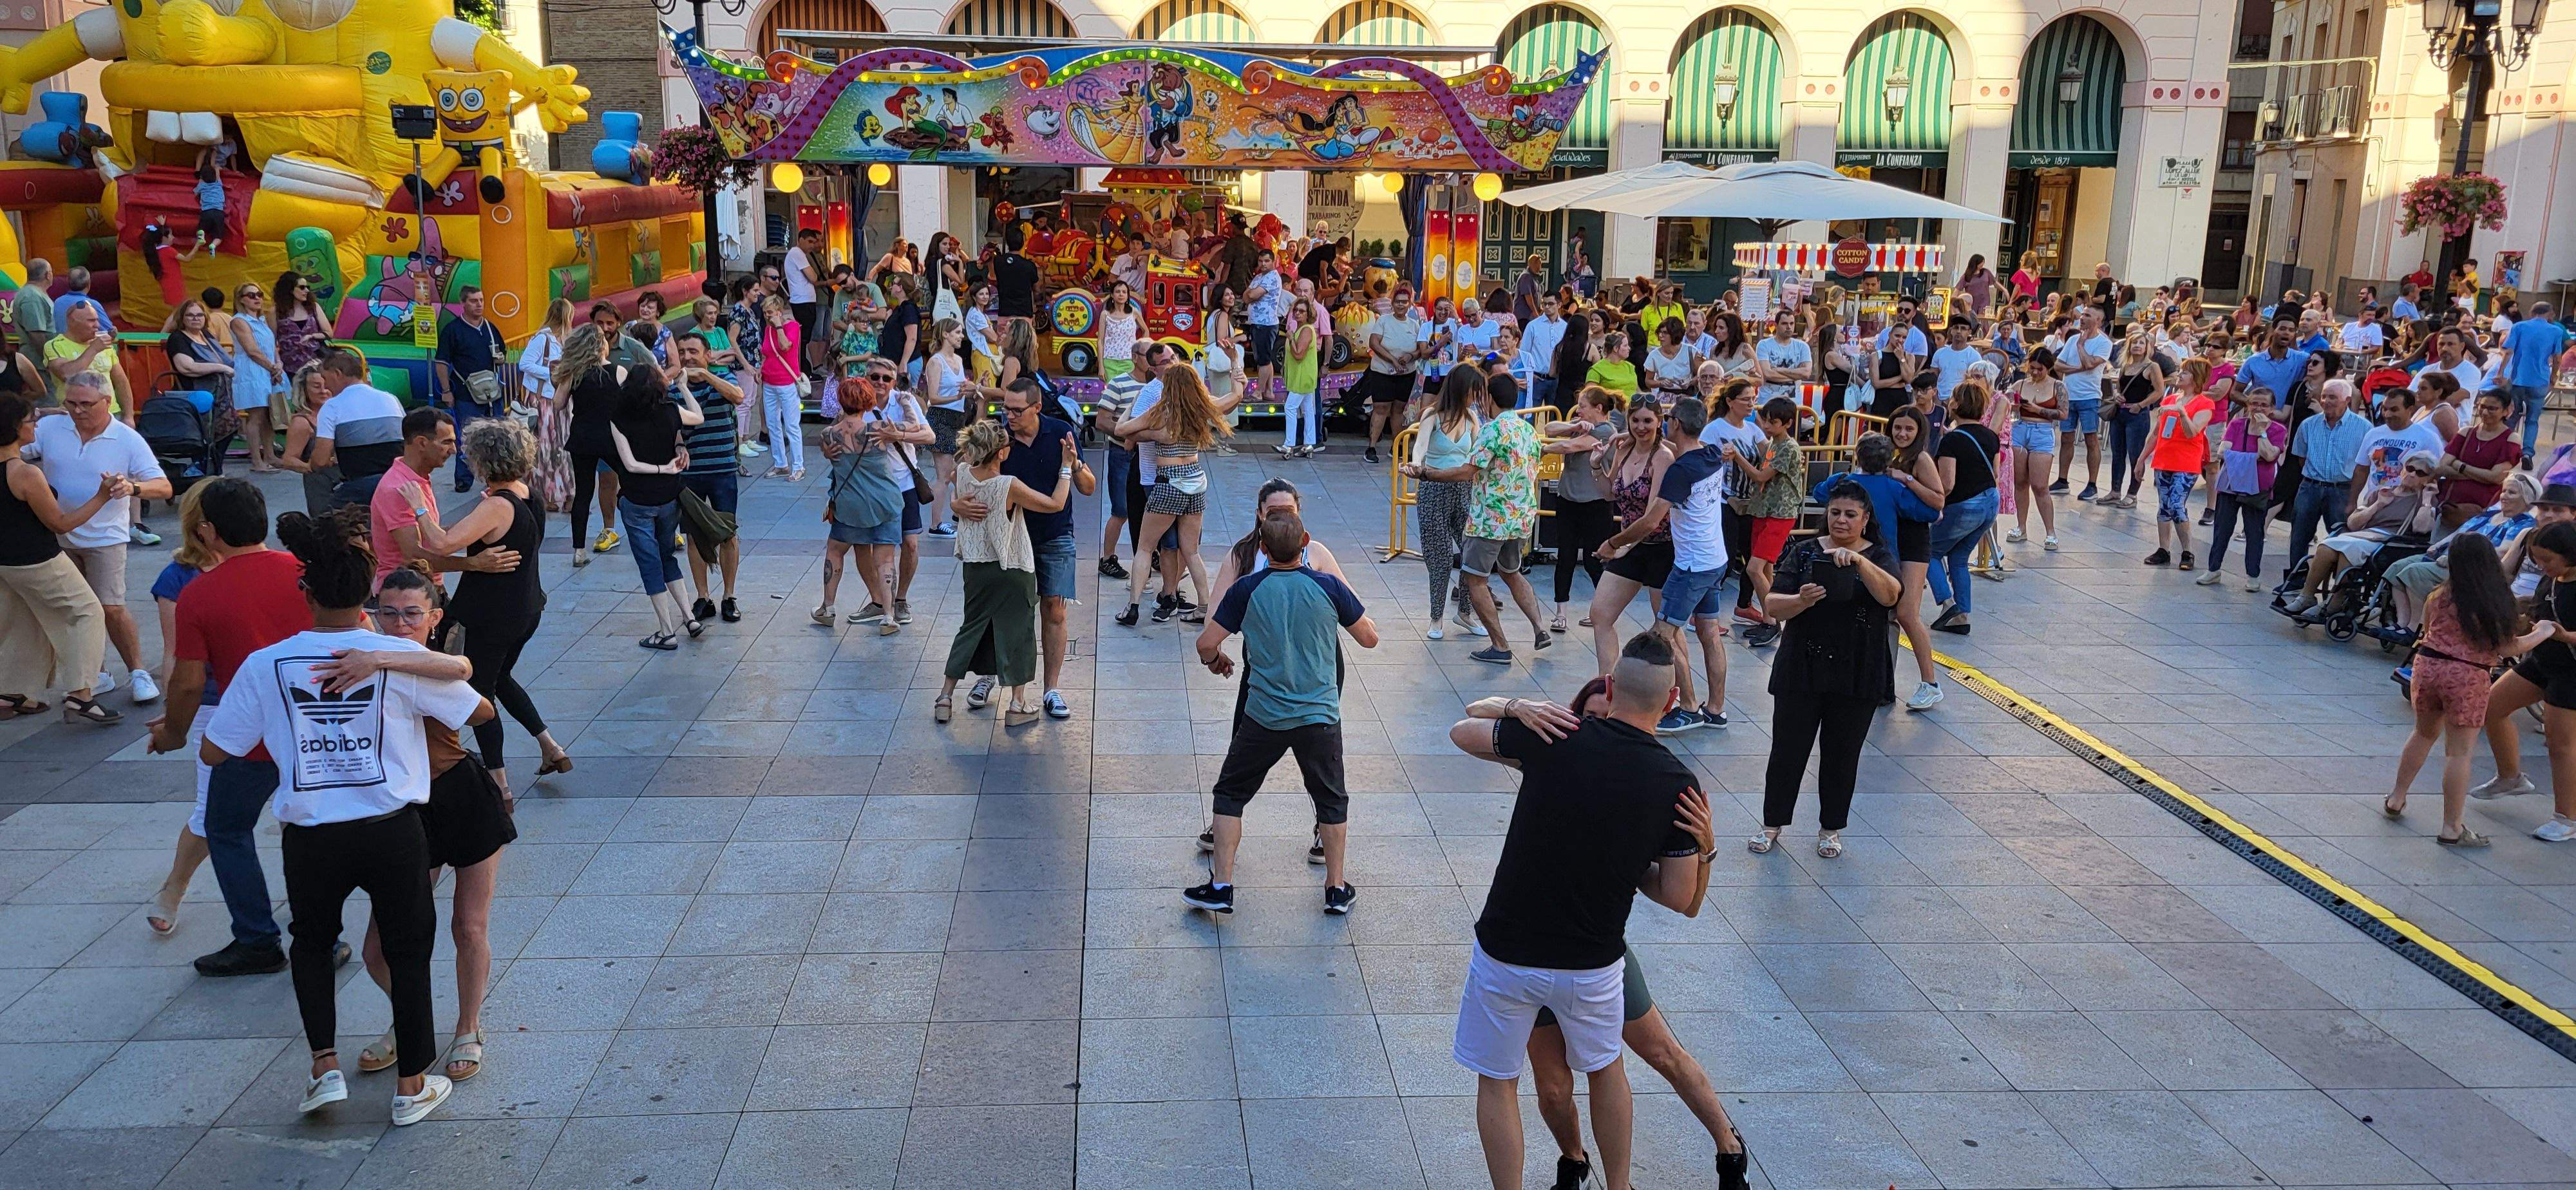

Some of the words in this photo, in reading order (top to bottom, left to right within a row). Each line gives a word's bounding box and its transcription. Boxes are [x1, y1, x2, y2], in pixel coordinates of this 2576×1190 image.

[1551, 151, 1591, 162] ecialidades
[1886, 153, 1922, 166] CONFIANZA
[2030, 155, 2051, 165] desde
[2054, 156, 2070, 166] 1871
[1307, 189, 1349, 206] STIENDA
